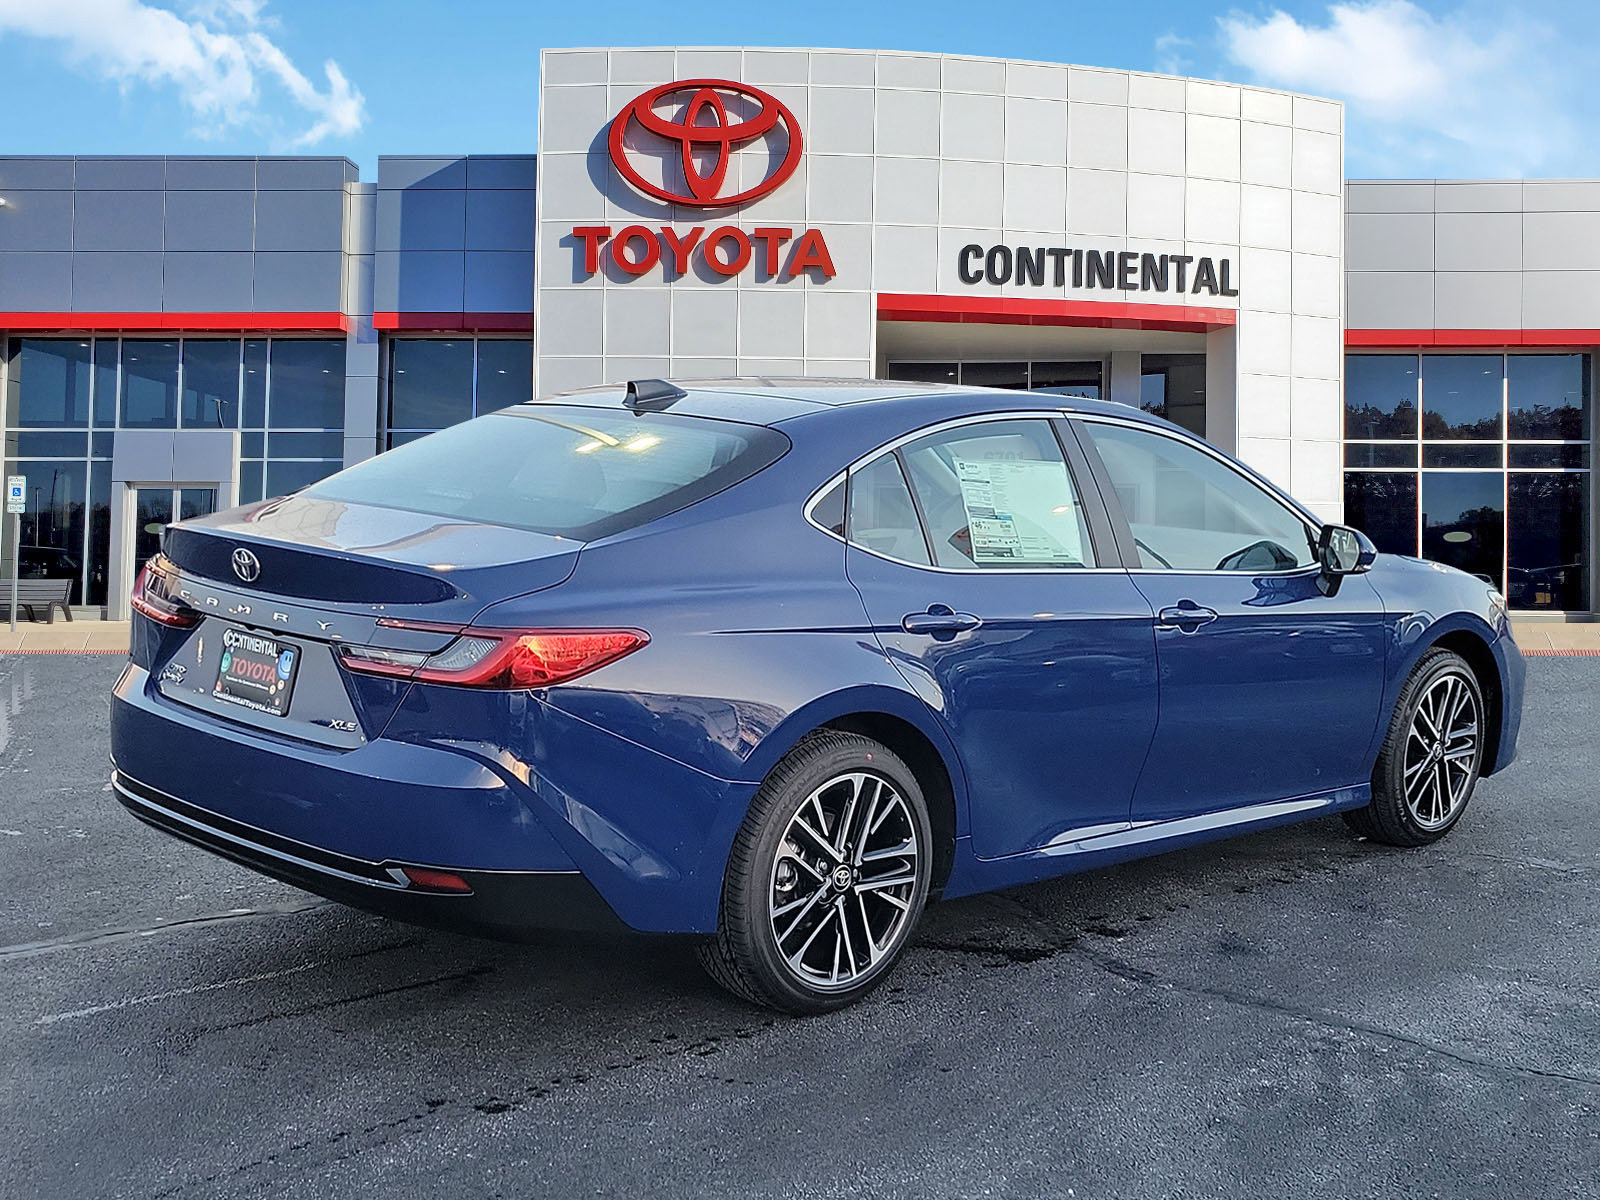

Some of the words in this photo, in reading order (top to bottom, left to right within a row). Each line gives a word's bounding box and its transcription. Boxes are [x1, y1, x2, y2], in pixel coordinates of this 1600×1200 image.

[572, 224, 837, 277] TOYOTA
[958, 244, 1239, 297] CONTINENTAL
[180, 589, 334, 631] CAMRY
[223, 628, 279, 658] CONTINENTAL
[231, 656, 277, 684] TOYOTA
[328, 719, 358, 732] XLE
